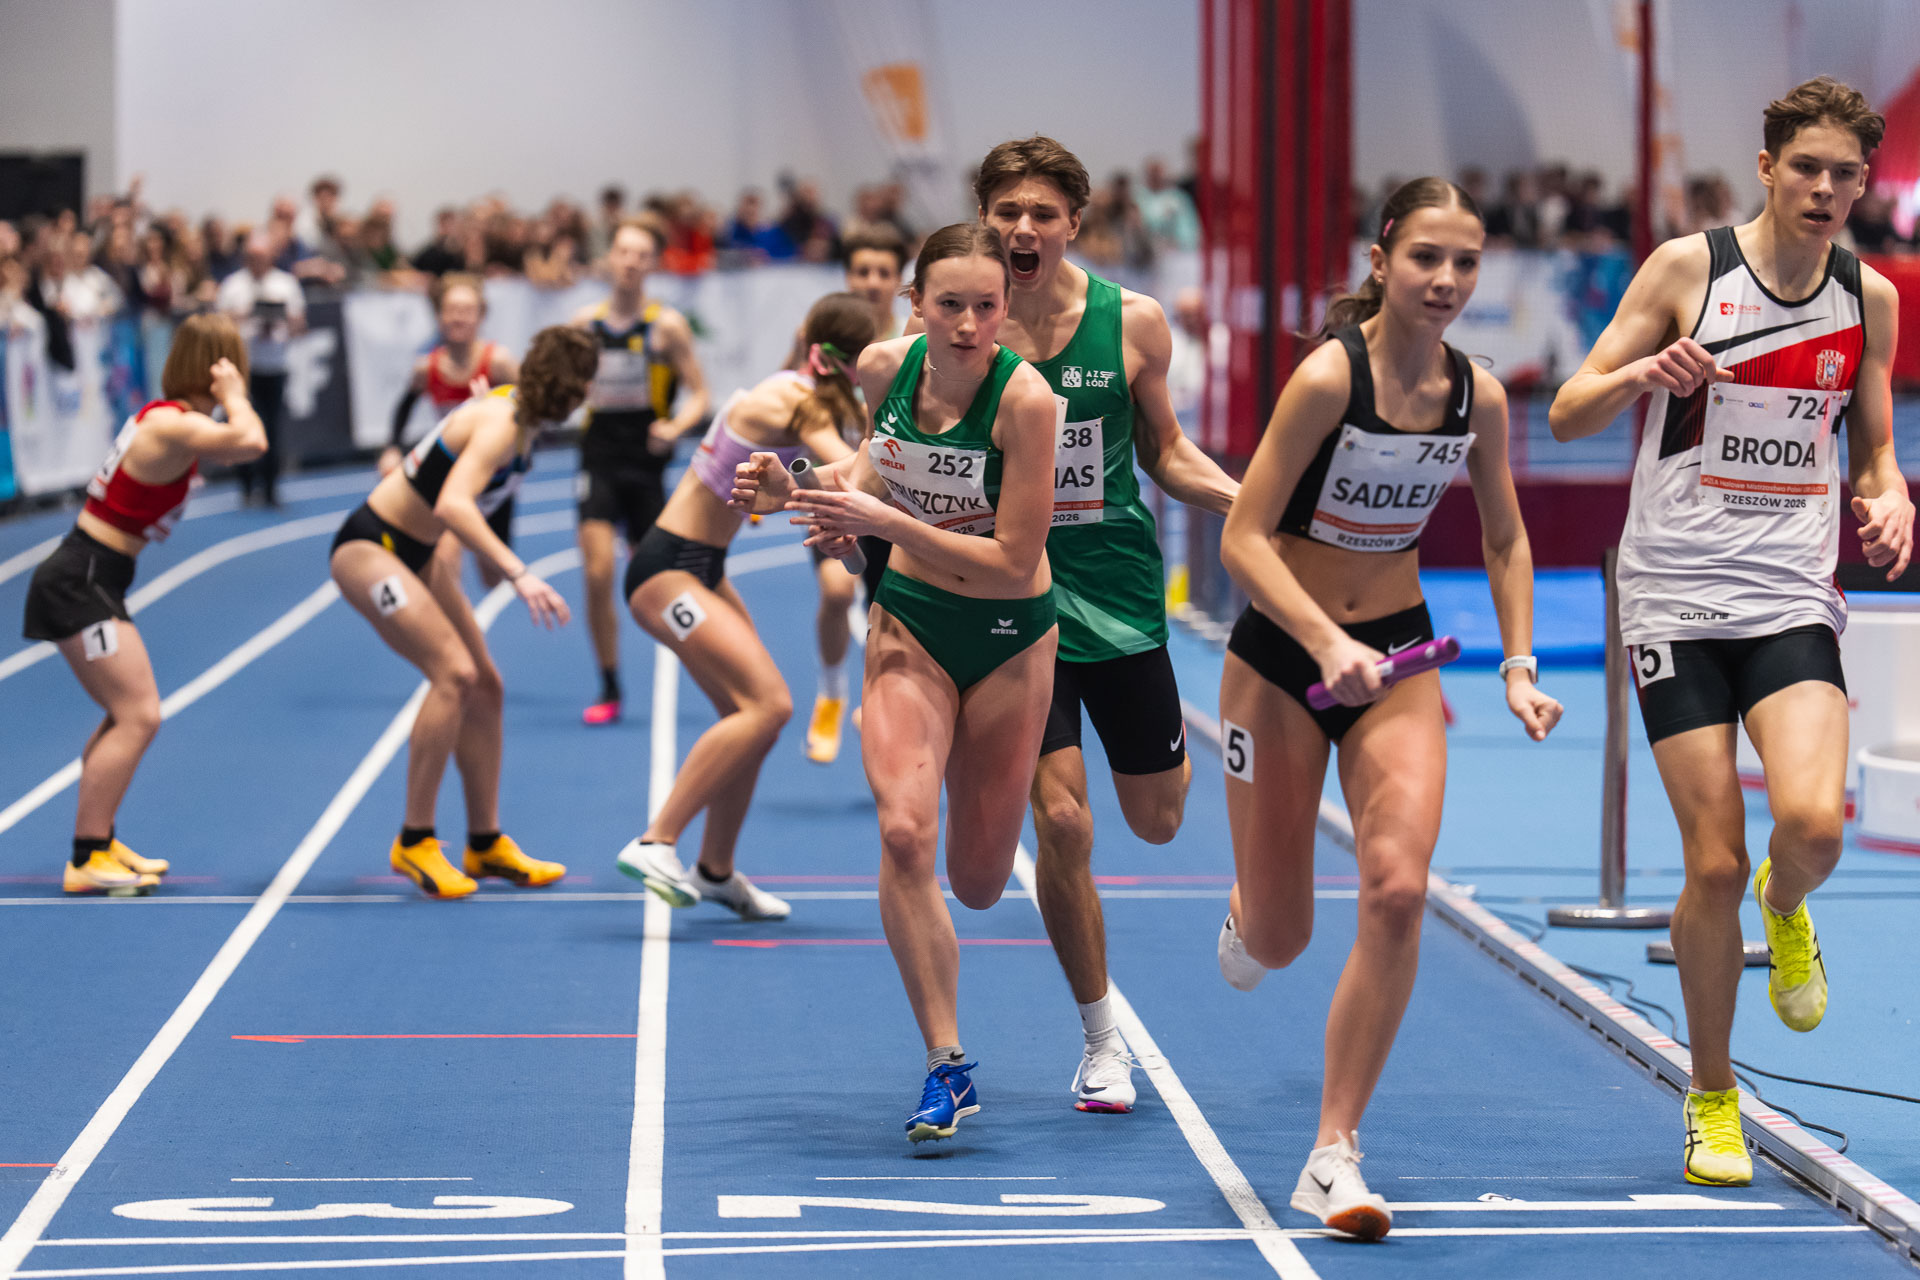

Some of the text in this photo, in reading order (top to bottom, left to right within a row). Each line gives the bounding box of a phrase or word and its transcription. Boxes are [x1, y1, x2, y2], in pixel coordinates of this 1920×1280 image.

[1787, 394, 1830, 420] 724
[1059, 427, 1092, 448] 38
[1416, 441, 1464, 465] 745
[1721, 434, 1816, 468] BRODA
[880, 457, 905, 471] ORLEN
[928, 452, 973, 478] 252
[1723, 494, 1807, 508] RZESZÓW 2026
[1052, 513, 1080, 523] 2026
[1337, 532, 1395, 547] RZESZÓW
[379, 583, 398, 609] 4
[671, 602, 695, 630] 6
[1680, 612, 1730, 621] CUTLINE
[93, 627, 107, 652] 1
[991, 627, 1018, 635] erima
[1638, 643, 1662, 679] 5
[1227, 727, 1246, 774] 5
